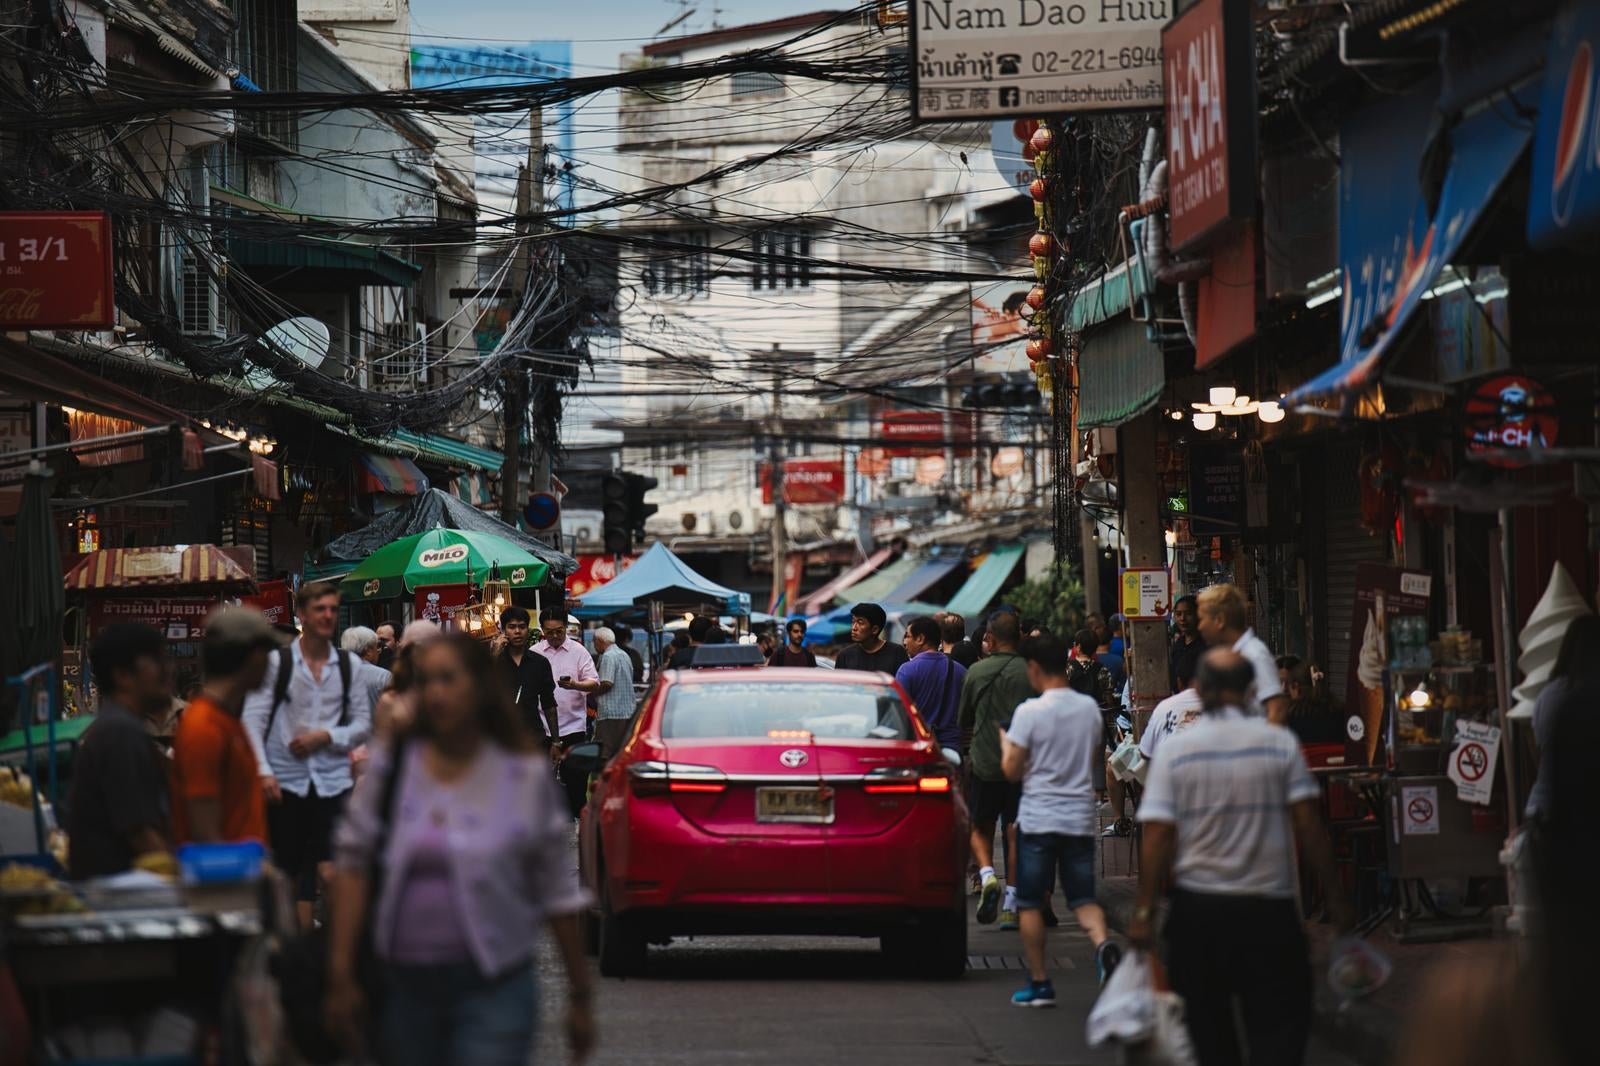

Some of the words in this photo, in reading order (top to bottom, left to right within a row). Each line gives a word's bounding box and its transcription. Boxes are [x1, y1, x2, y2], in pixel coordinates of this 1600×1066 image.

[922, 0, 1005, 31] Nam
[1018, 0, 1086, 27] Dao
[1098, 0, 1167, 23] Huu
[18, 236, 69, 262] 3/1
[423, 551, 465, 563] MILO
